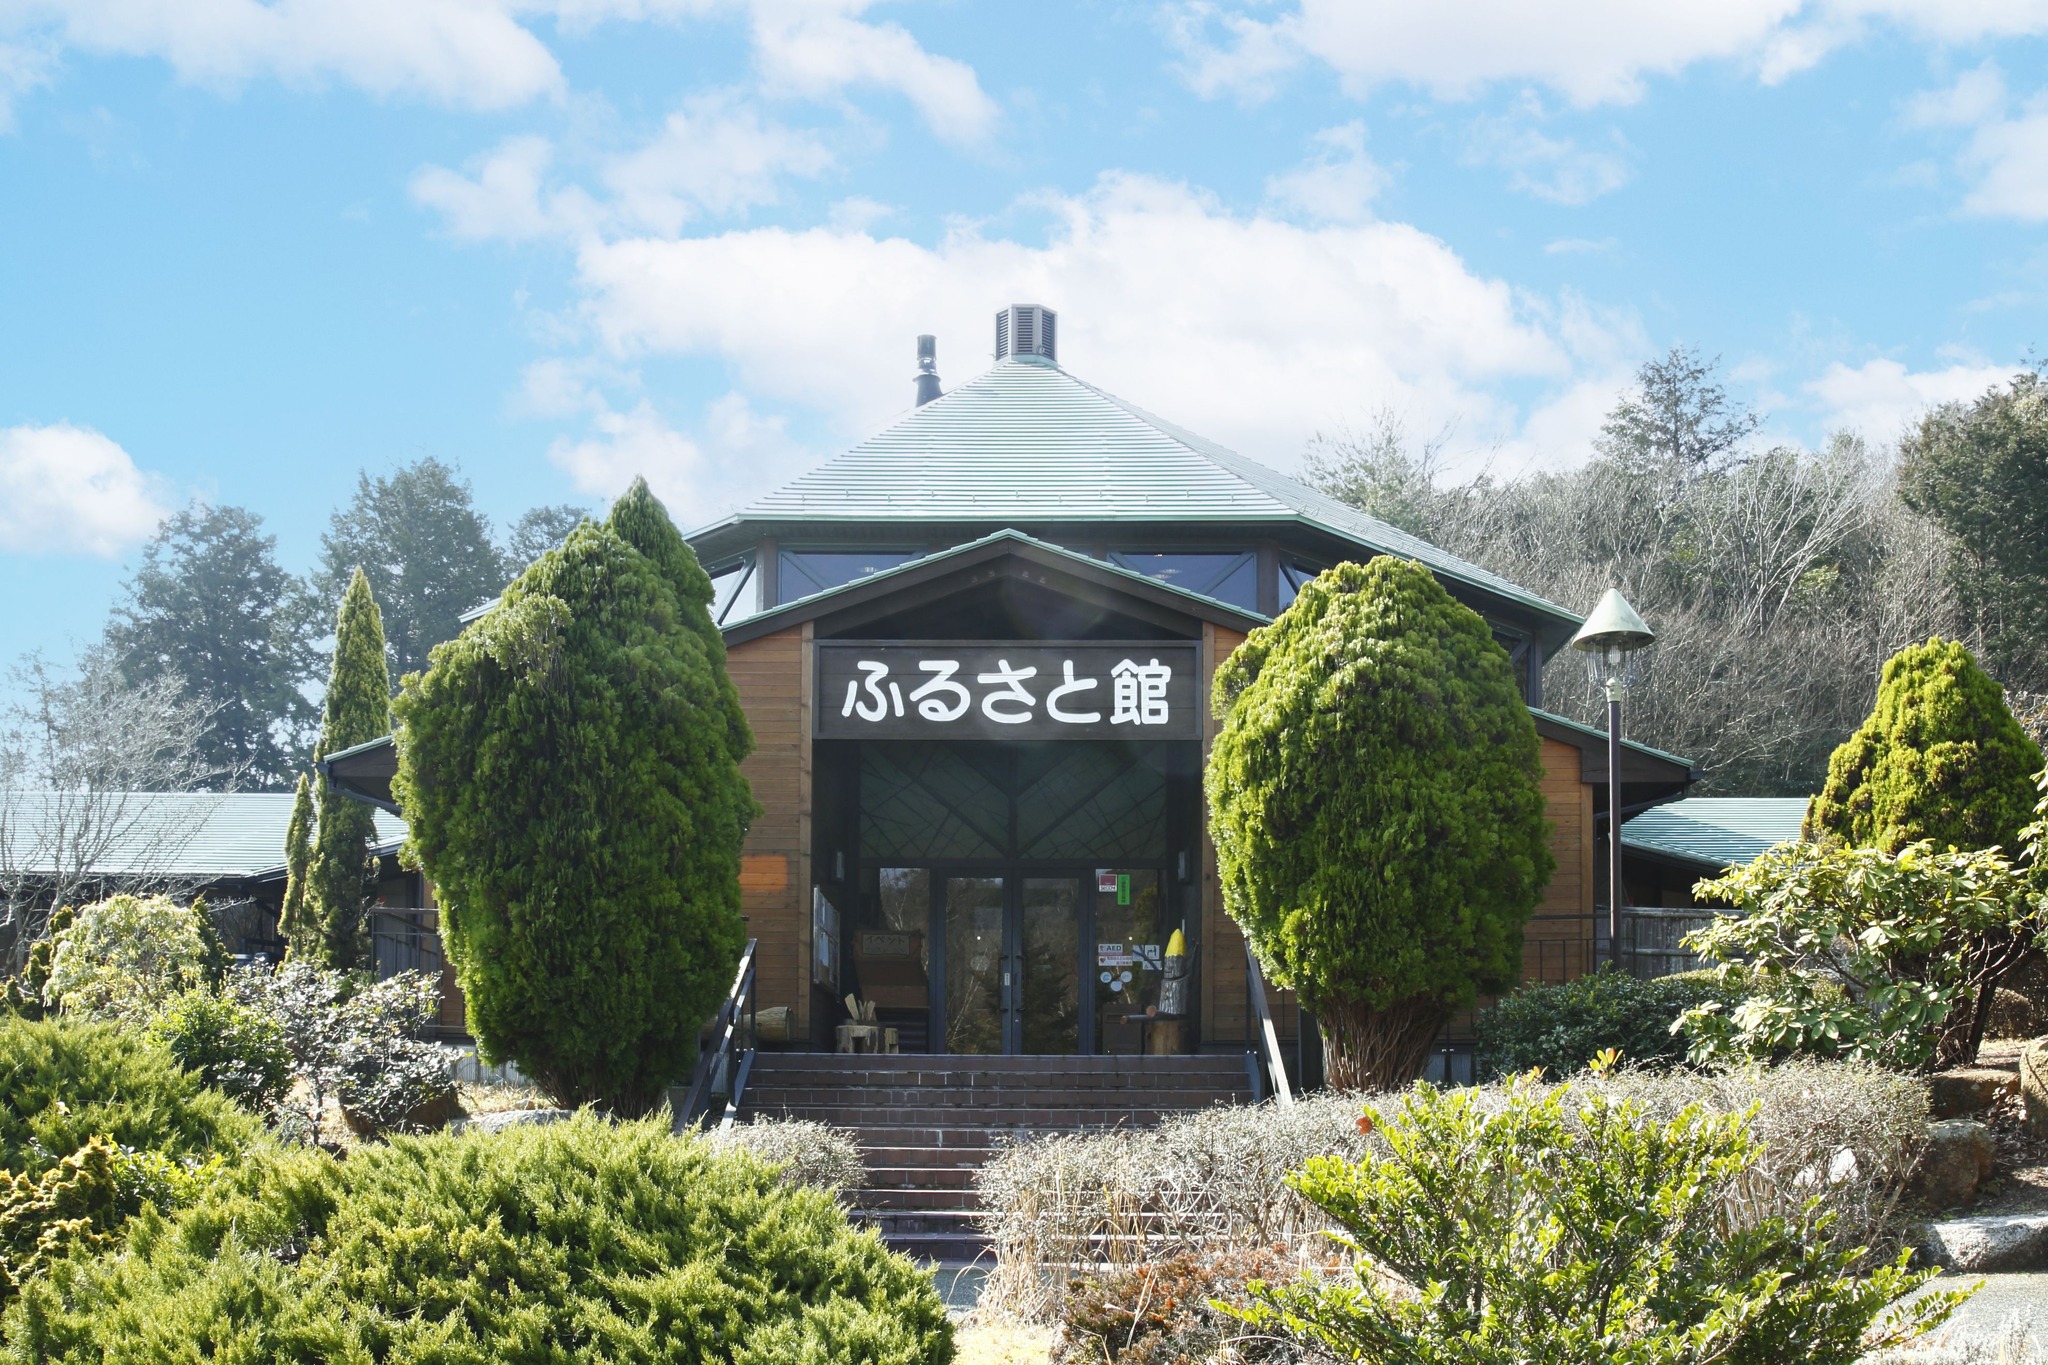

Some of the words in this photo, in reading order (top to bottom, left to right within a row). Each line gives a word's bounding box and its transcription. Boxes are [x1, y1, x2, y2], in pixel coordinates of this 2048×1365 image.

[841, 658, 1172, 725] ふるさと館
[865, 935, 905, 945] イベント
